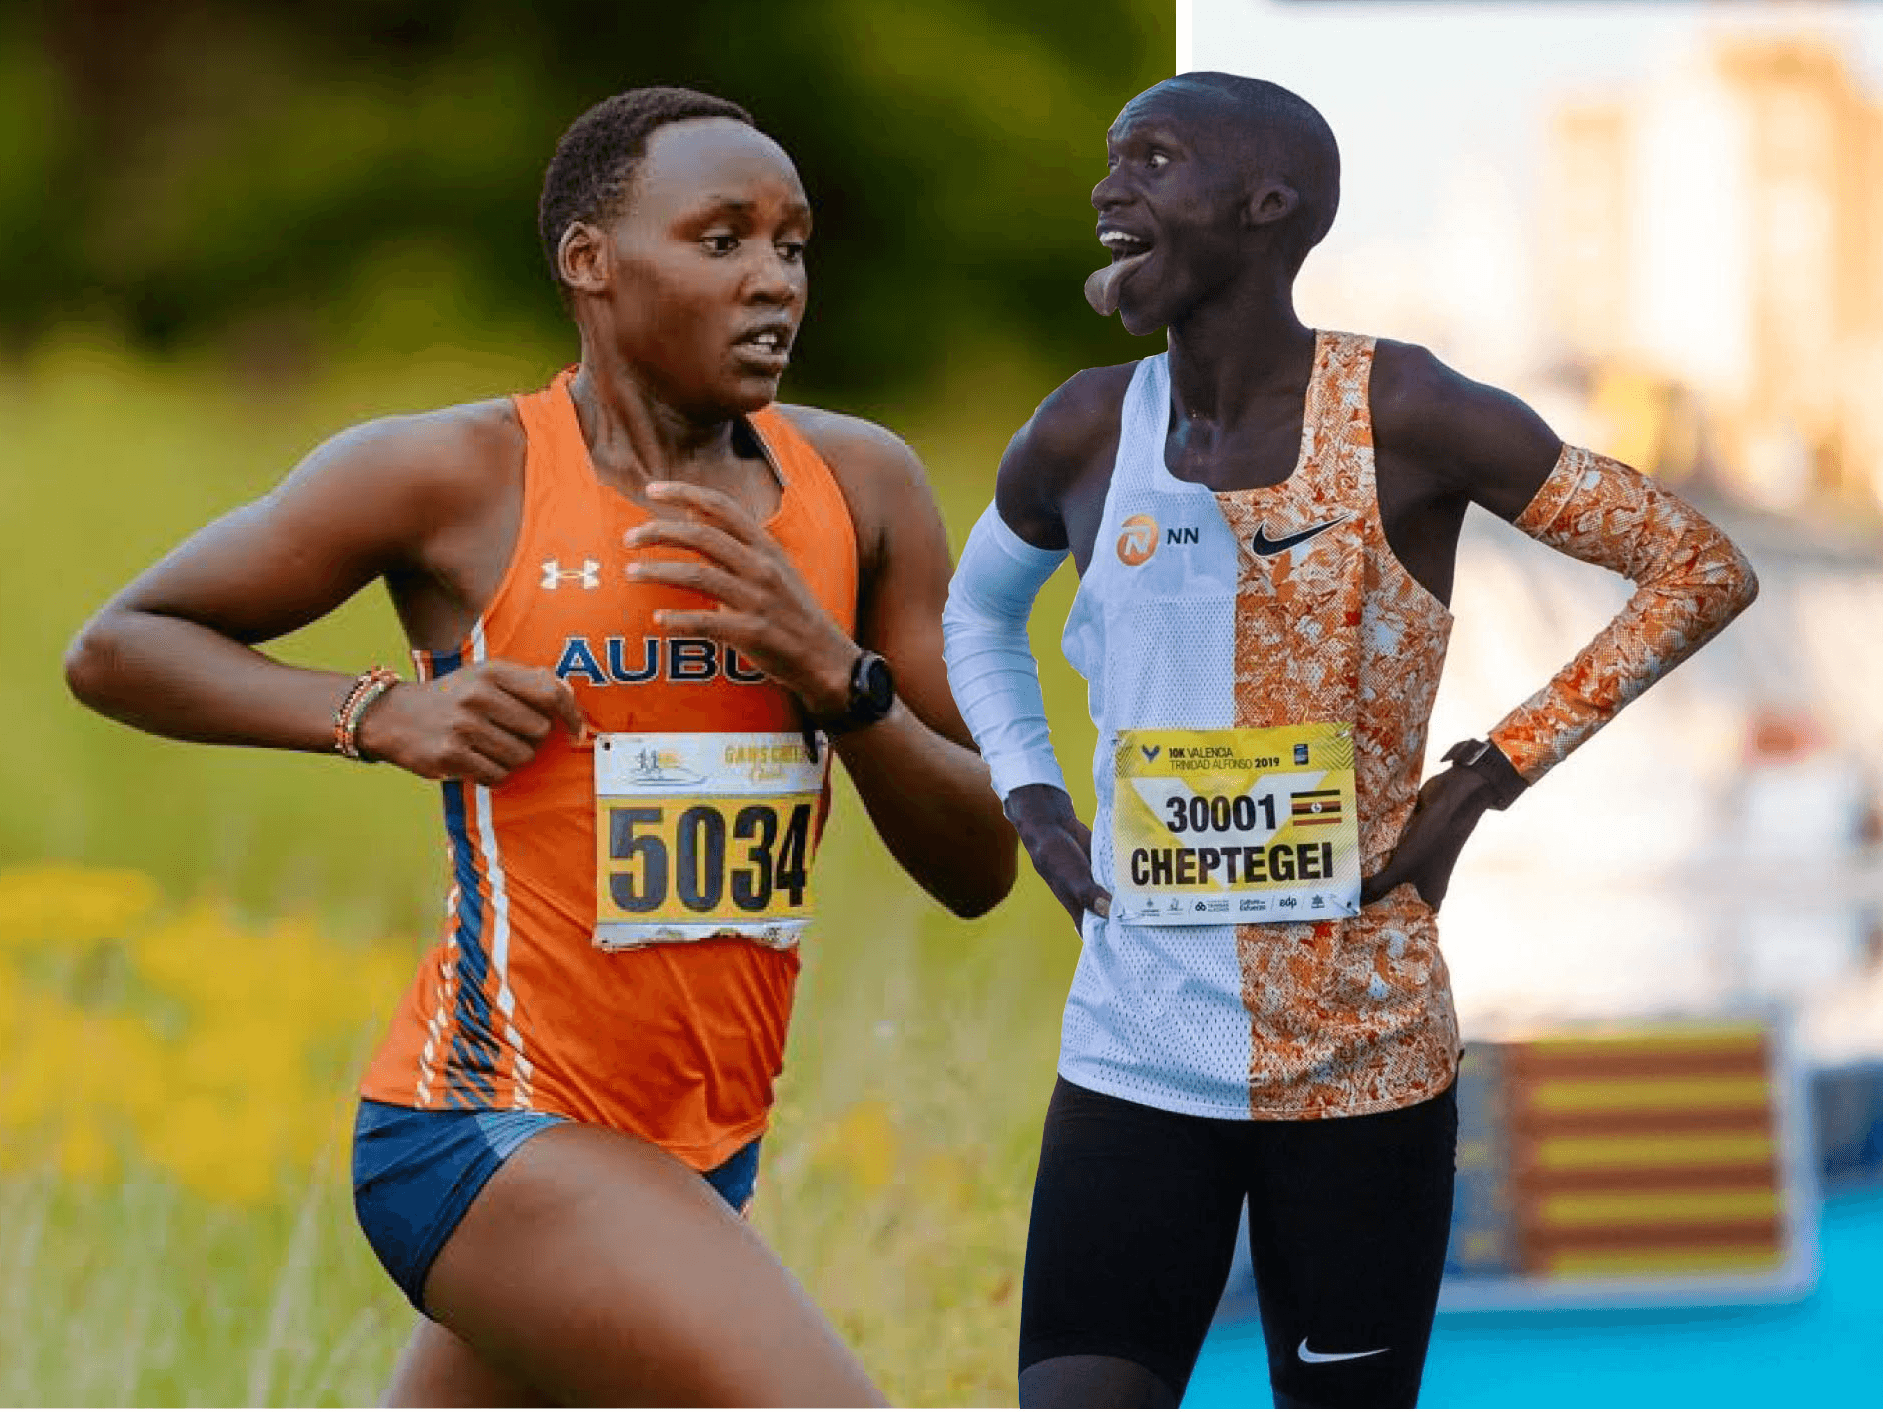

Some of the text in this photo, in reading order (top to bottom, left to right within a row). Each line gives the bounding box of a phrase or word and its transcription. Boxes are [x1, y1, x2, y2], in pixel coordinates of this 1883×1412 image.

[1167, 527, 1199, 544] NN
[1168, 747, 1234, 759] 10K VALENCIA
[1169, 757, 1280, 770] TRINIDAD ALFONSO 2019
[1166, 794, 1276, 833] 30001
[609, 804, 811, 912] 5034
[1131, 842, 1333, 886] CHEPTEGEI
